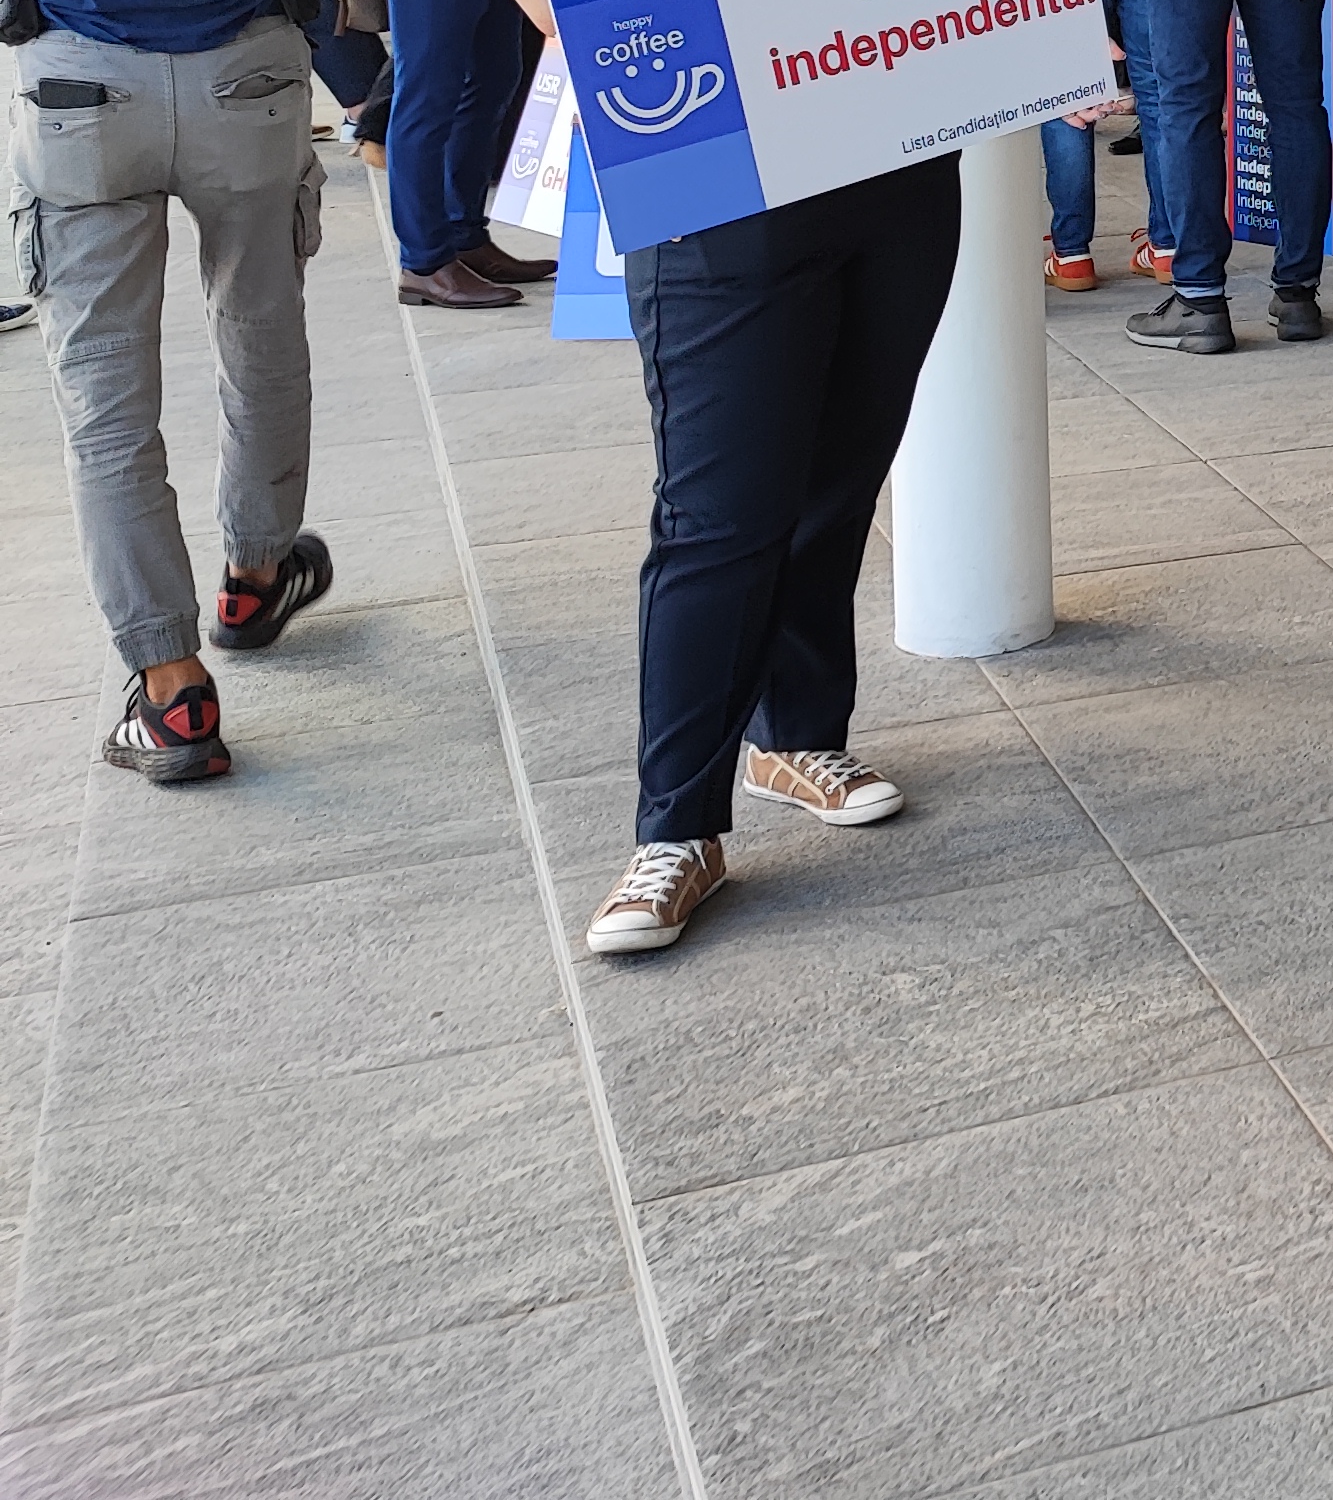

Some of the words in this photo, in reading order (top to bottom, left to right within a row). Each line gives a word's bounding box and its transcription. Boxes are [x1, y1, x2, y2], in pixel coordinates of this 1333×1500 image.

[612, 14, 653, 31] happy
[595, 30, 685, 66] coffee
[901, 133, 935, 154] Lista
[1237, 176, 1271, 196] Indep
